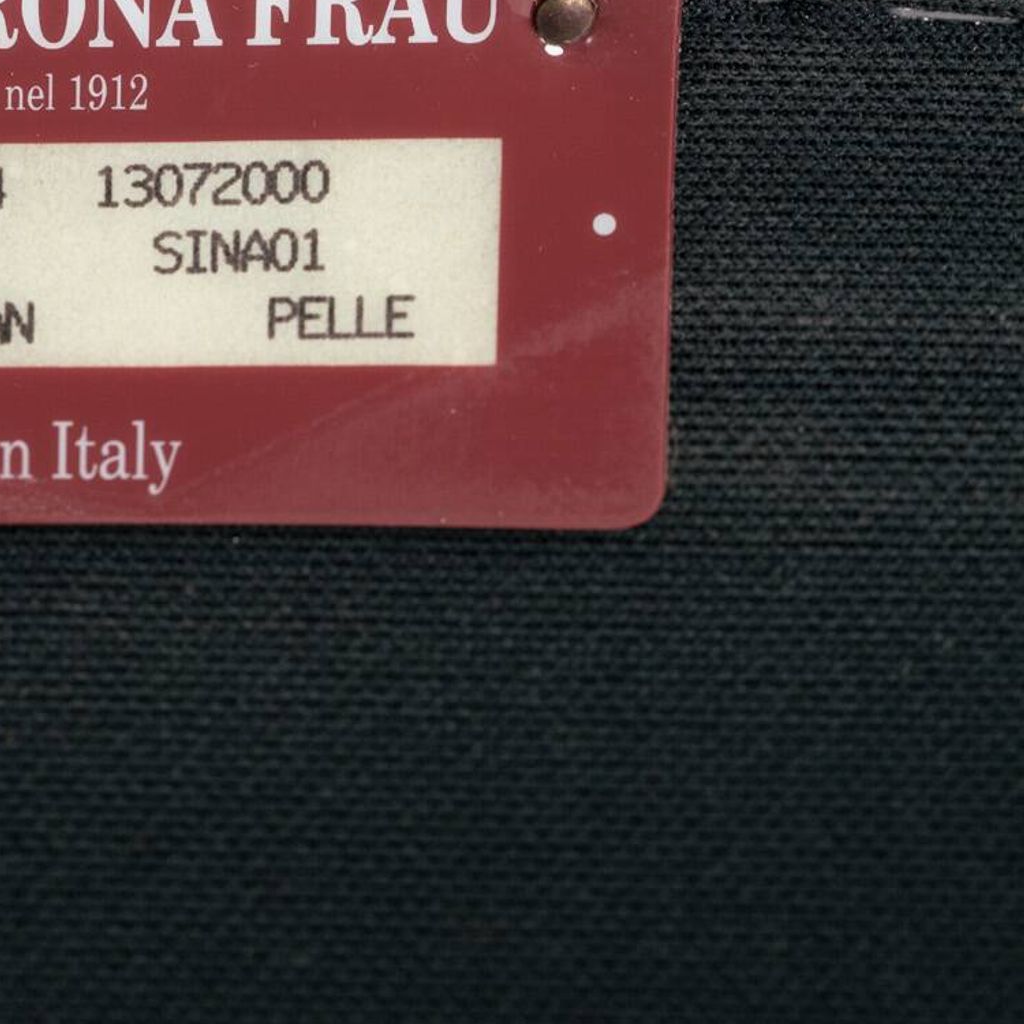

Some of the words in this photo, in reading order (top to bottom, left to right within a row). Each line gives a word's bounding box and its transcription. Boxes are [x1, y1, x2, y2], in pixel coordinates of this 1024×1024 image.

[5, 74, 55, 111] nel
[70, 74, 149, 111] 1912
[97, 160, 331, 208] 13072000
[152, 229, 325, 275] SINA01
[267, 295, 416, 340] PELLE
[52, 420, 182, 495] Italy
